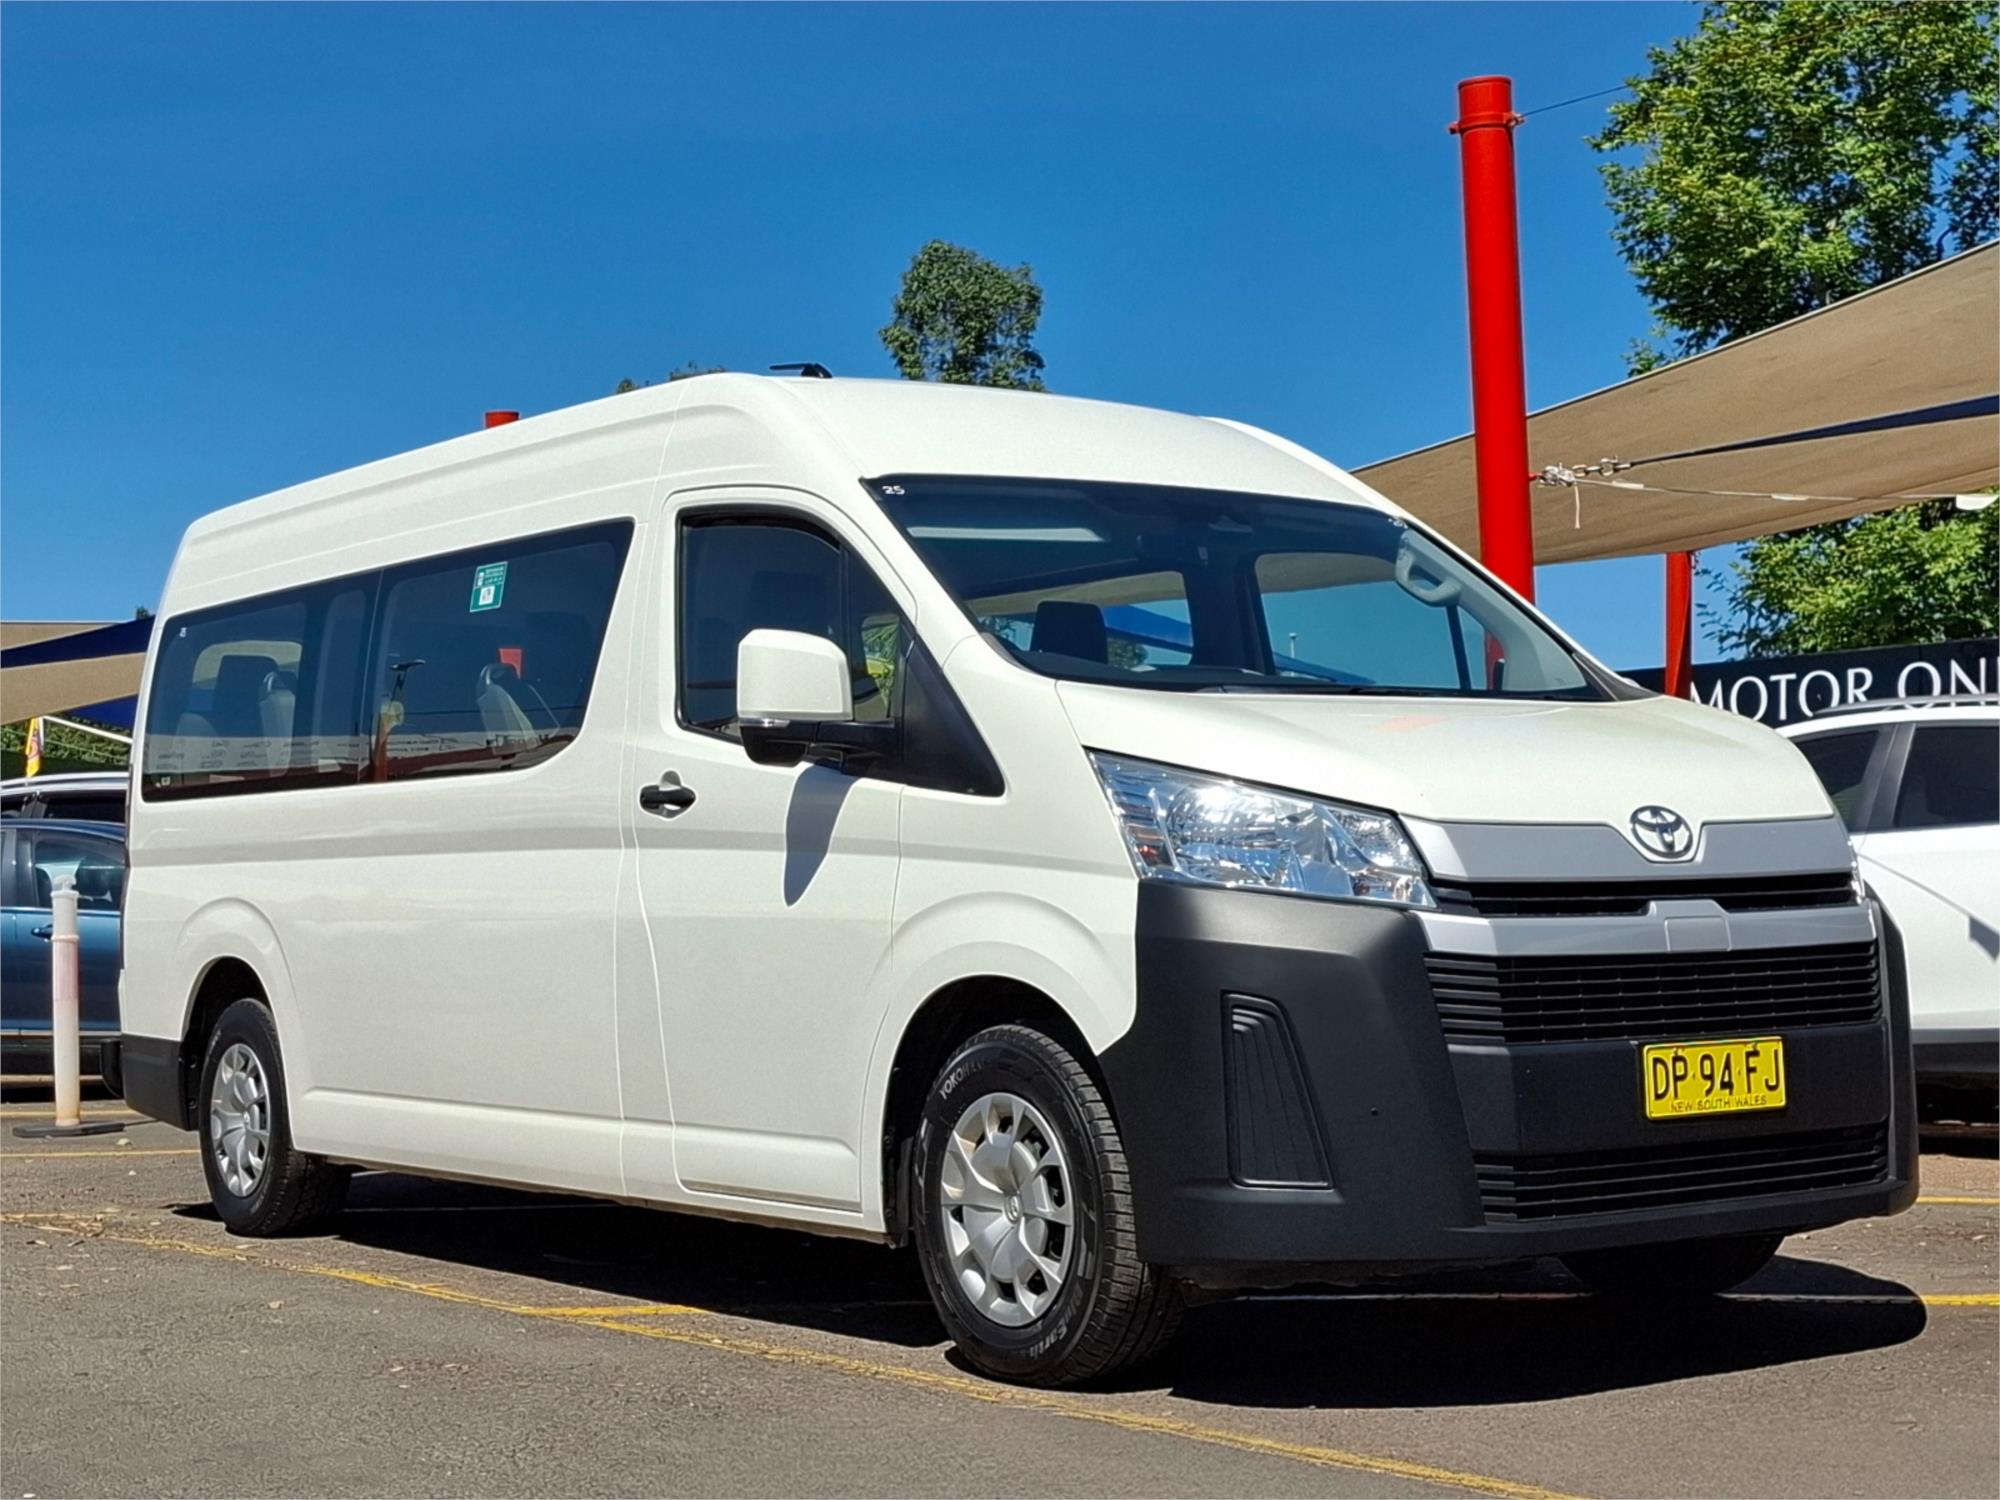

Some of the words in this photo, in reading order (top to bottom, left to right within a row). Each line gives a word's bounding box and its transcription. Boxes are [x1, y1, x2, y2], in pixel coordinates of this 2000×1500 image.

[882, 485, 905, 495] 25
[1691, 667, 1874, 721] MOTOR
[1898, 655, 1999, 709] ON
[1670, 1101, 1693, 1113] NEW
[1697, 1099, 1730, 1111] SOUTH
[1736, 1095, 1767, 1108] WALES
